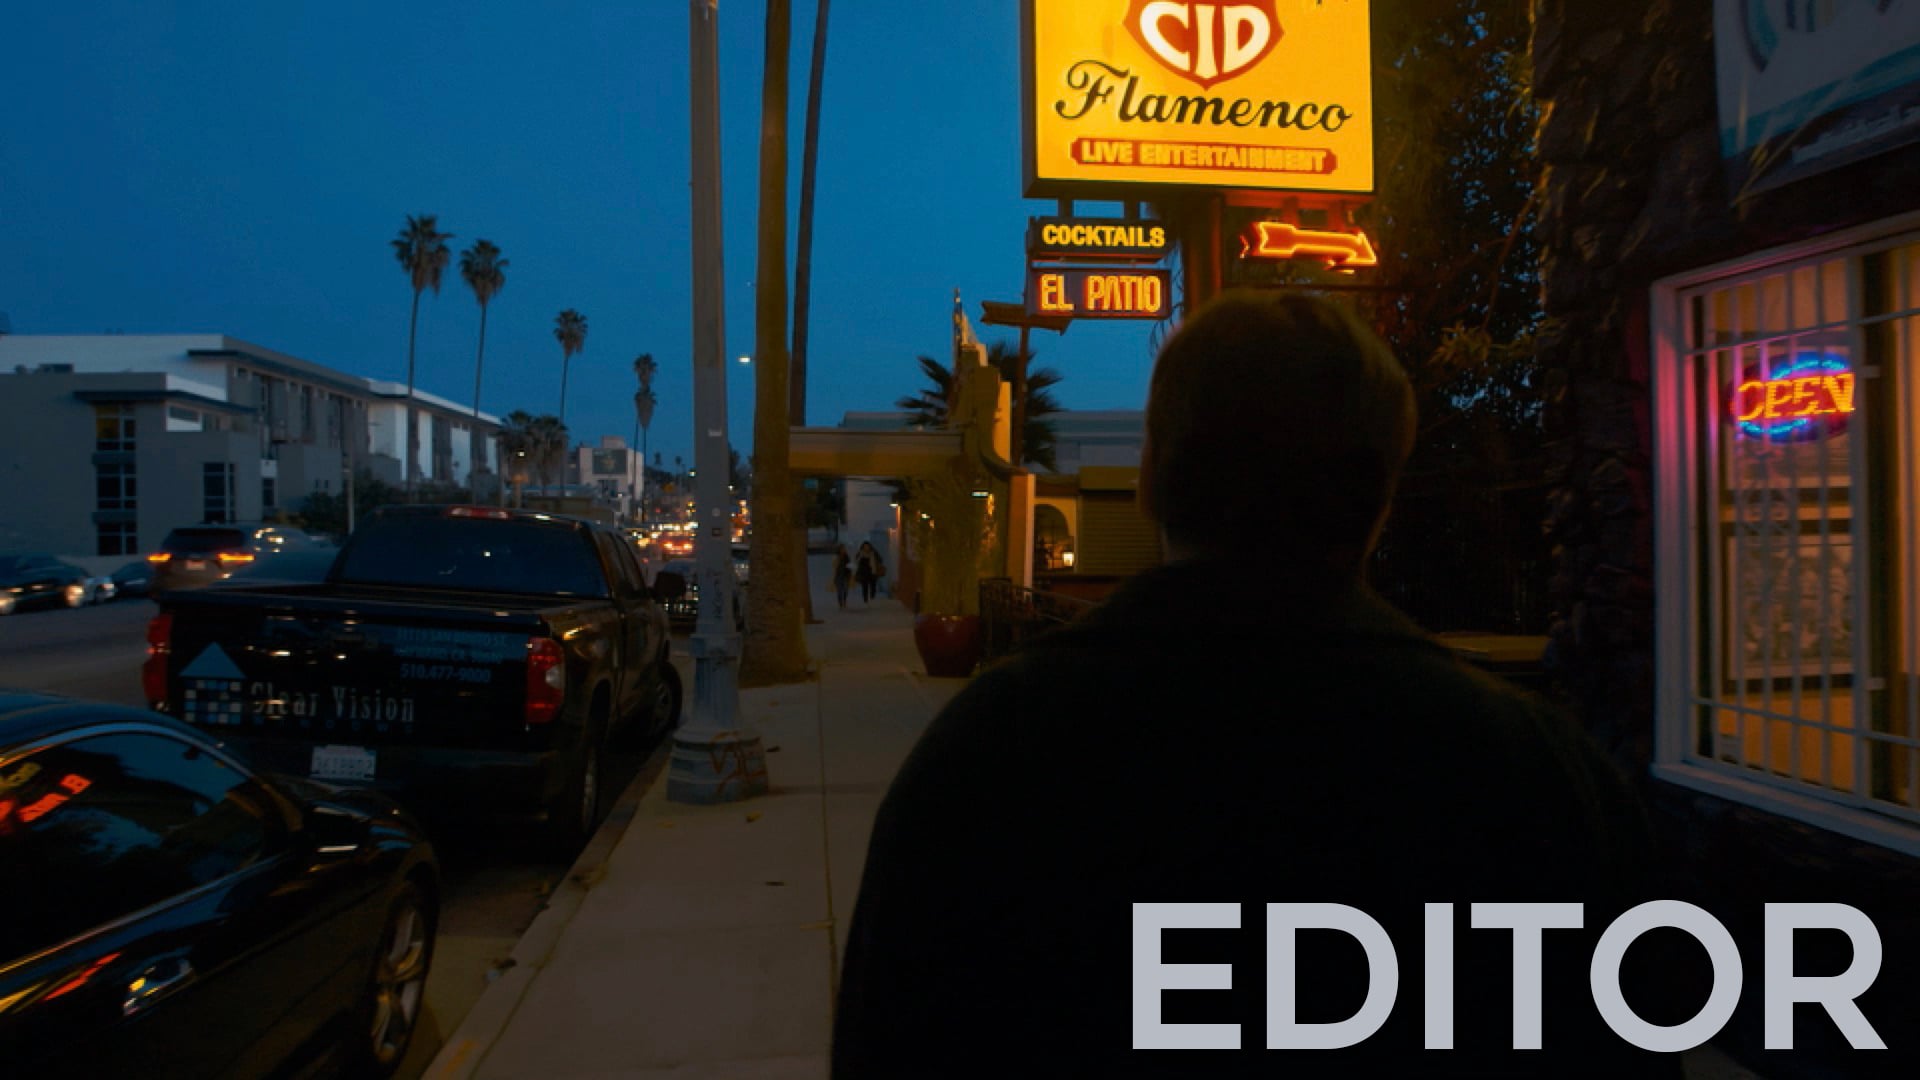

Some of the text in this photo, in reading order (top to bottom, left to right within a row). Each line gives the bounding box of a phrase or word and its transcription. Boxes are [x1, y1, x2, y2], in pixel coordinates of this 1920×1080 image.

[1140, 1, 1271, 79] CID
[1055, 59, 1352, 132] Flamenco
[1081, 140, 1326, 172] LIVE ENTERTAINMENT
[1042, 224, 1165, 247] COCKTAILS
[1041, 273, 1161, 313] EL PATIO
[1737, 373, 1855, 421] OPEN
[251, 681, 415, 722] Clear Vision
